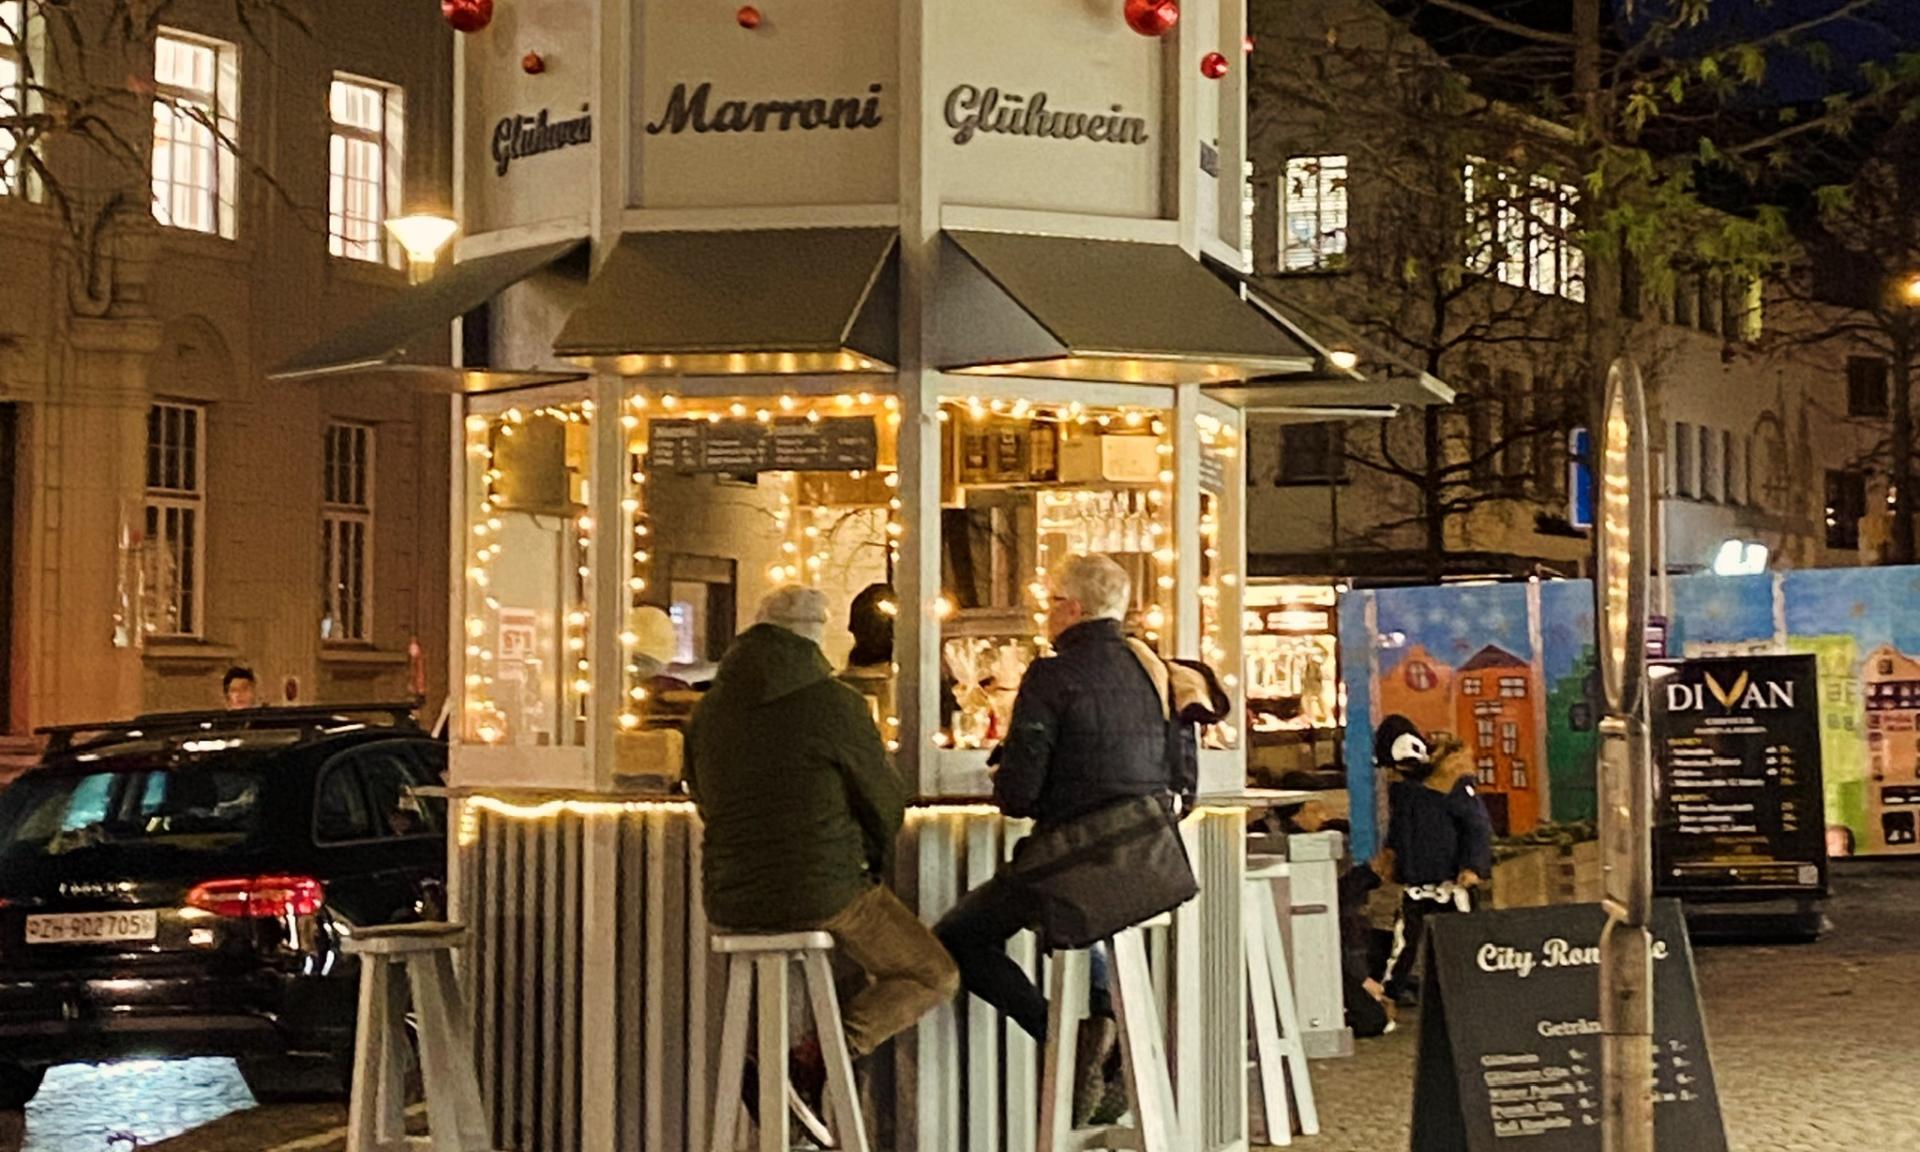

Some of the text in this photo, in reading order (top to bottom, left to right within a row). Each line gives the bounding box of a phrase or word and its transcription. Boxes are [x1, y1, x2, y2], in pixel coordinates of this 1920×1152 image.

[646, 82, 882, 134] Marroni
[944, 84, 1148, 145] Glühwein
[492, 102, 591, 177] Glühwei
[1667, 670, 1794, 711] DIVAN
[1477, 943, 1537, 977] City
